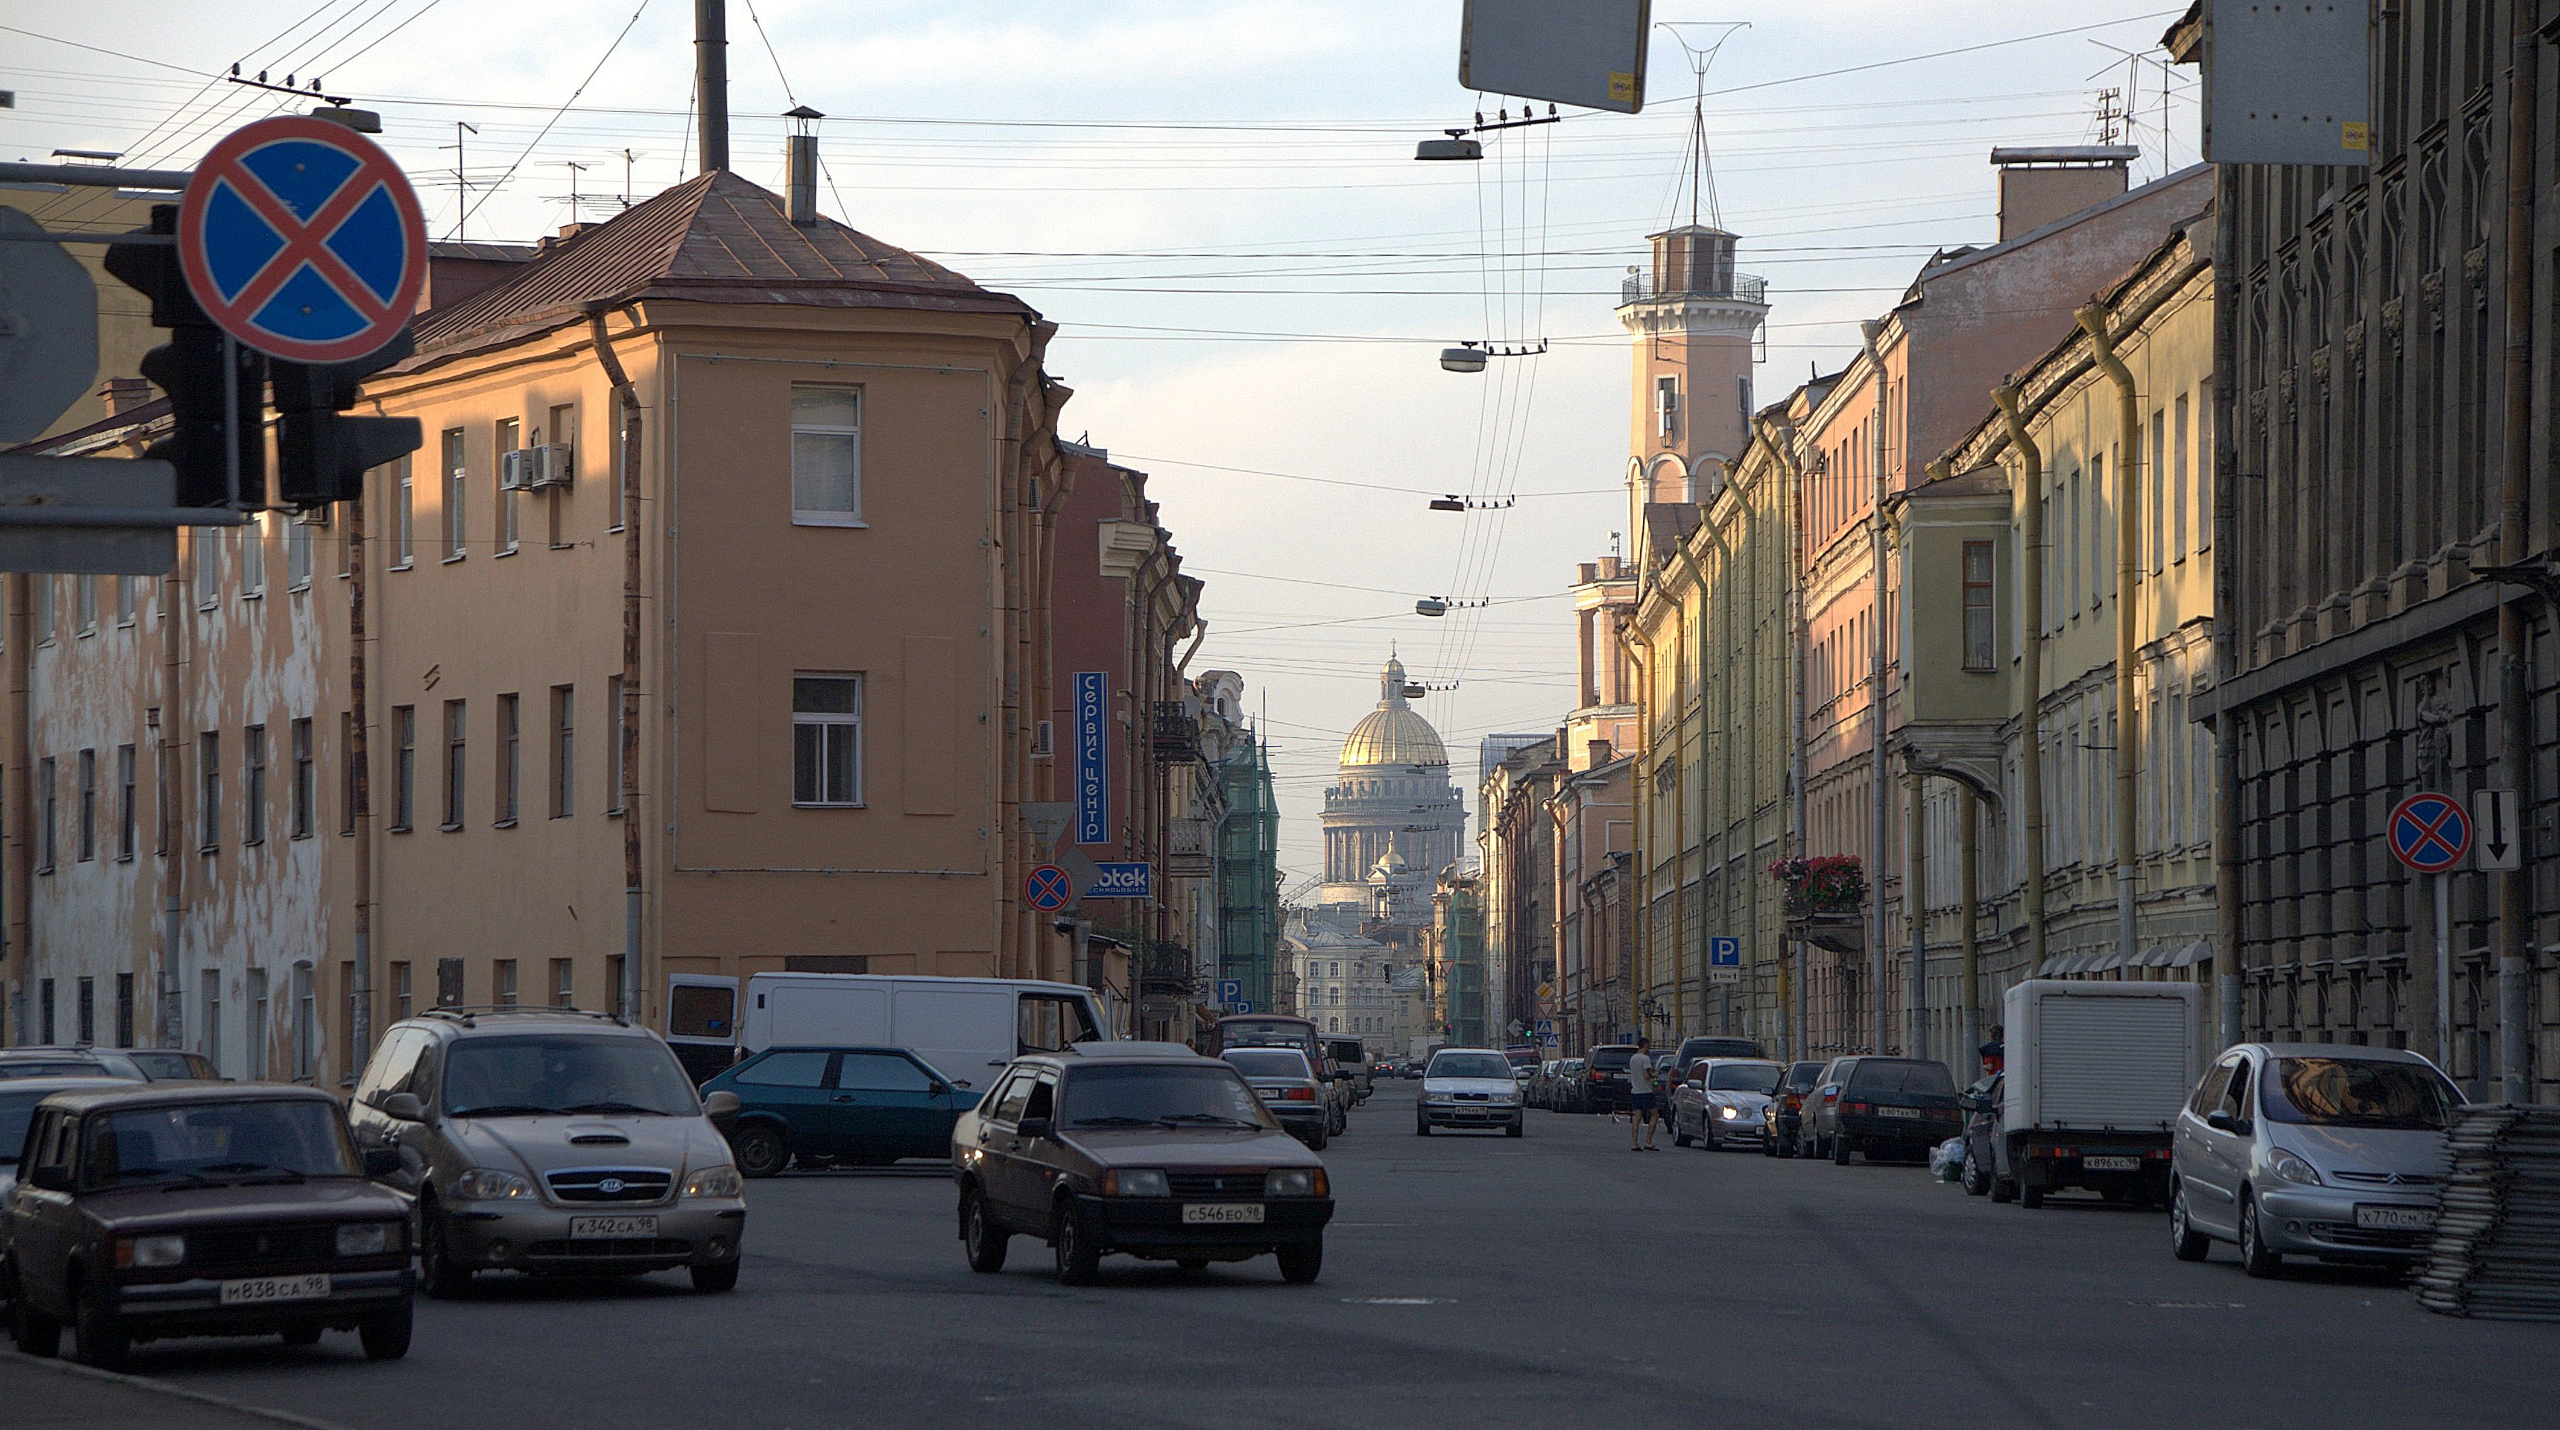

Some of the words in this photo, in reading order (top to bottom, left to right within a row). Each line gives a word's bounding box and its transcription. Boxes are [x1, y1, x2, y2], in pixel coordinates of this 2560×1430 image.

[1094, 868, 1146, 887] otek
[1719, 939, 1735, 964] P
[1224, 982, 1239, 1002] P
[1238, 1003, 1249, 1014] P
[1188, 1206, 1243, 1221] С546ЕО
[1246, 1206, 1260, 1217] 98
[2362, 1210, 2417, 1226] Х770СМ
[577, 1218, 635, 1234] К342СА
[637, 1218, 654, 1231] 98
[225, 1281, 300, 1301] М838СА
[304, 1276, 325, 1293] 98
